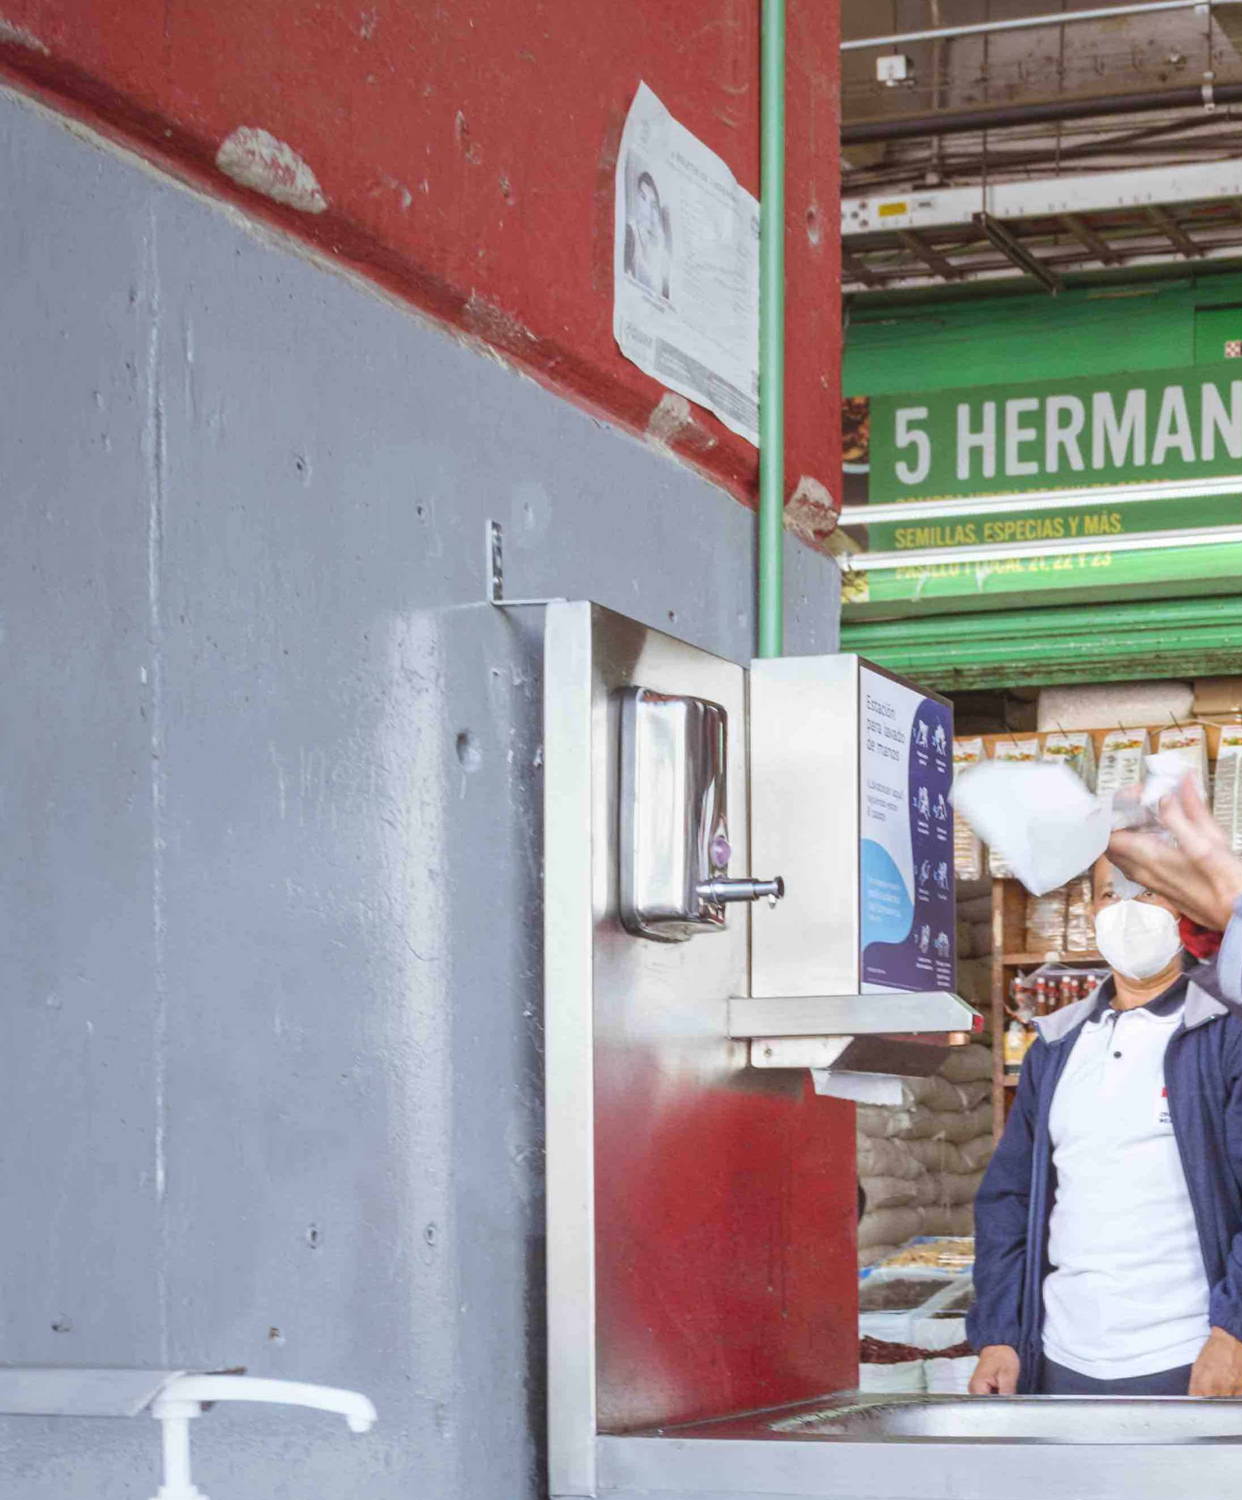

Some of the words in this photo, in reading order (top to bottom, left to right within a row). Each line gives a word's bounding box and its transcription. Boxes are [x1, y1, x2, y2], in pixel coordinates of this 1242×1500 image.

[894, 406, 932, 485] 5
[983, 517, 1065, 543] ESPECIAS
[1068, 517, 1079, 536] Y
